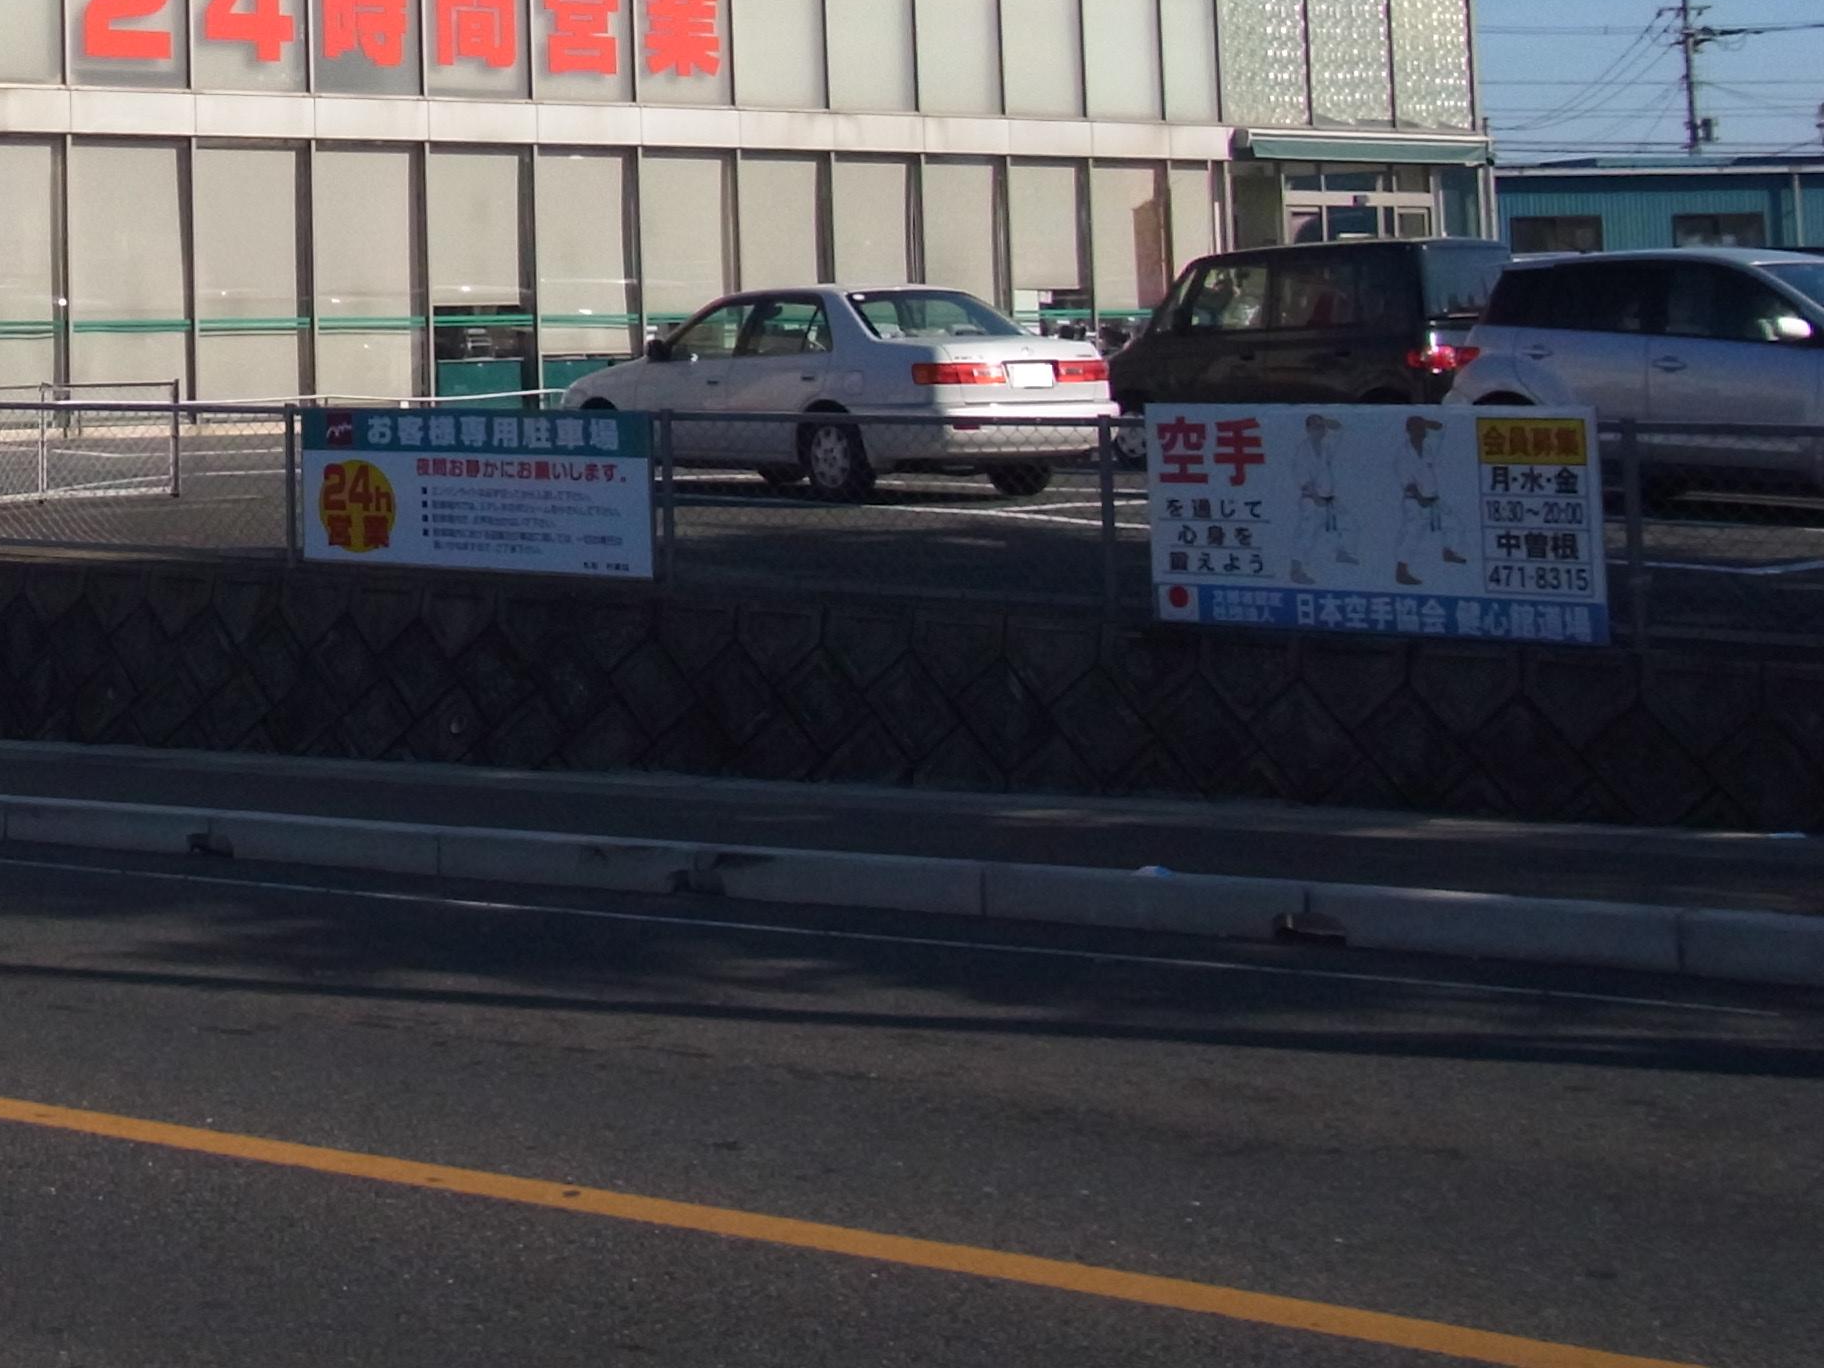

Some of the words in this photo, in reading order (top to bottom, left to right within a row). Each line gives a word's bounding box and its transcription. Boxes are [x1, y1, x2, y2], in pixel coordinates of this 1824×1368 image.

[367, 416, 619, 450] お客様専用駐車場
[1483, 426, 1580, 457] 会員募集
[1156, 416, 1266, 486] 空手
[416, 458, 626, 482] 夜間お静かにお願いします。
[1490, 466, 1579, 494] 月・水・金
[323, 463, 392, 513] 24h
[1166, 498, 1262, 519] を通じて
[328, 514, 390, 548] 営業
[1177, 525, 1252, 546] 心身を
[1488, 564, 1589, 592] 471-8315
[1296, 592, 1447, 634] 日本空手協会
